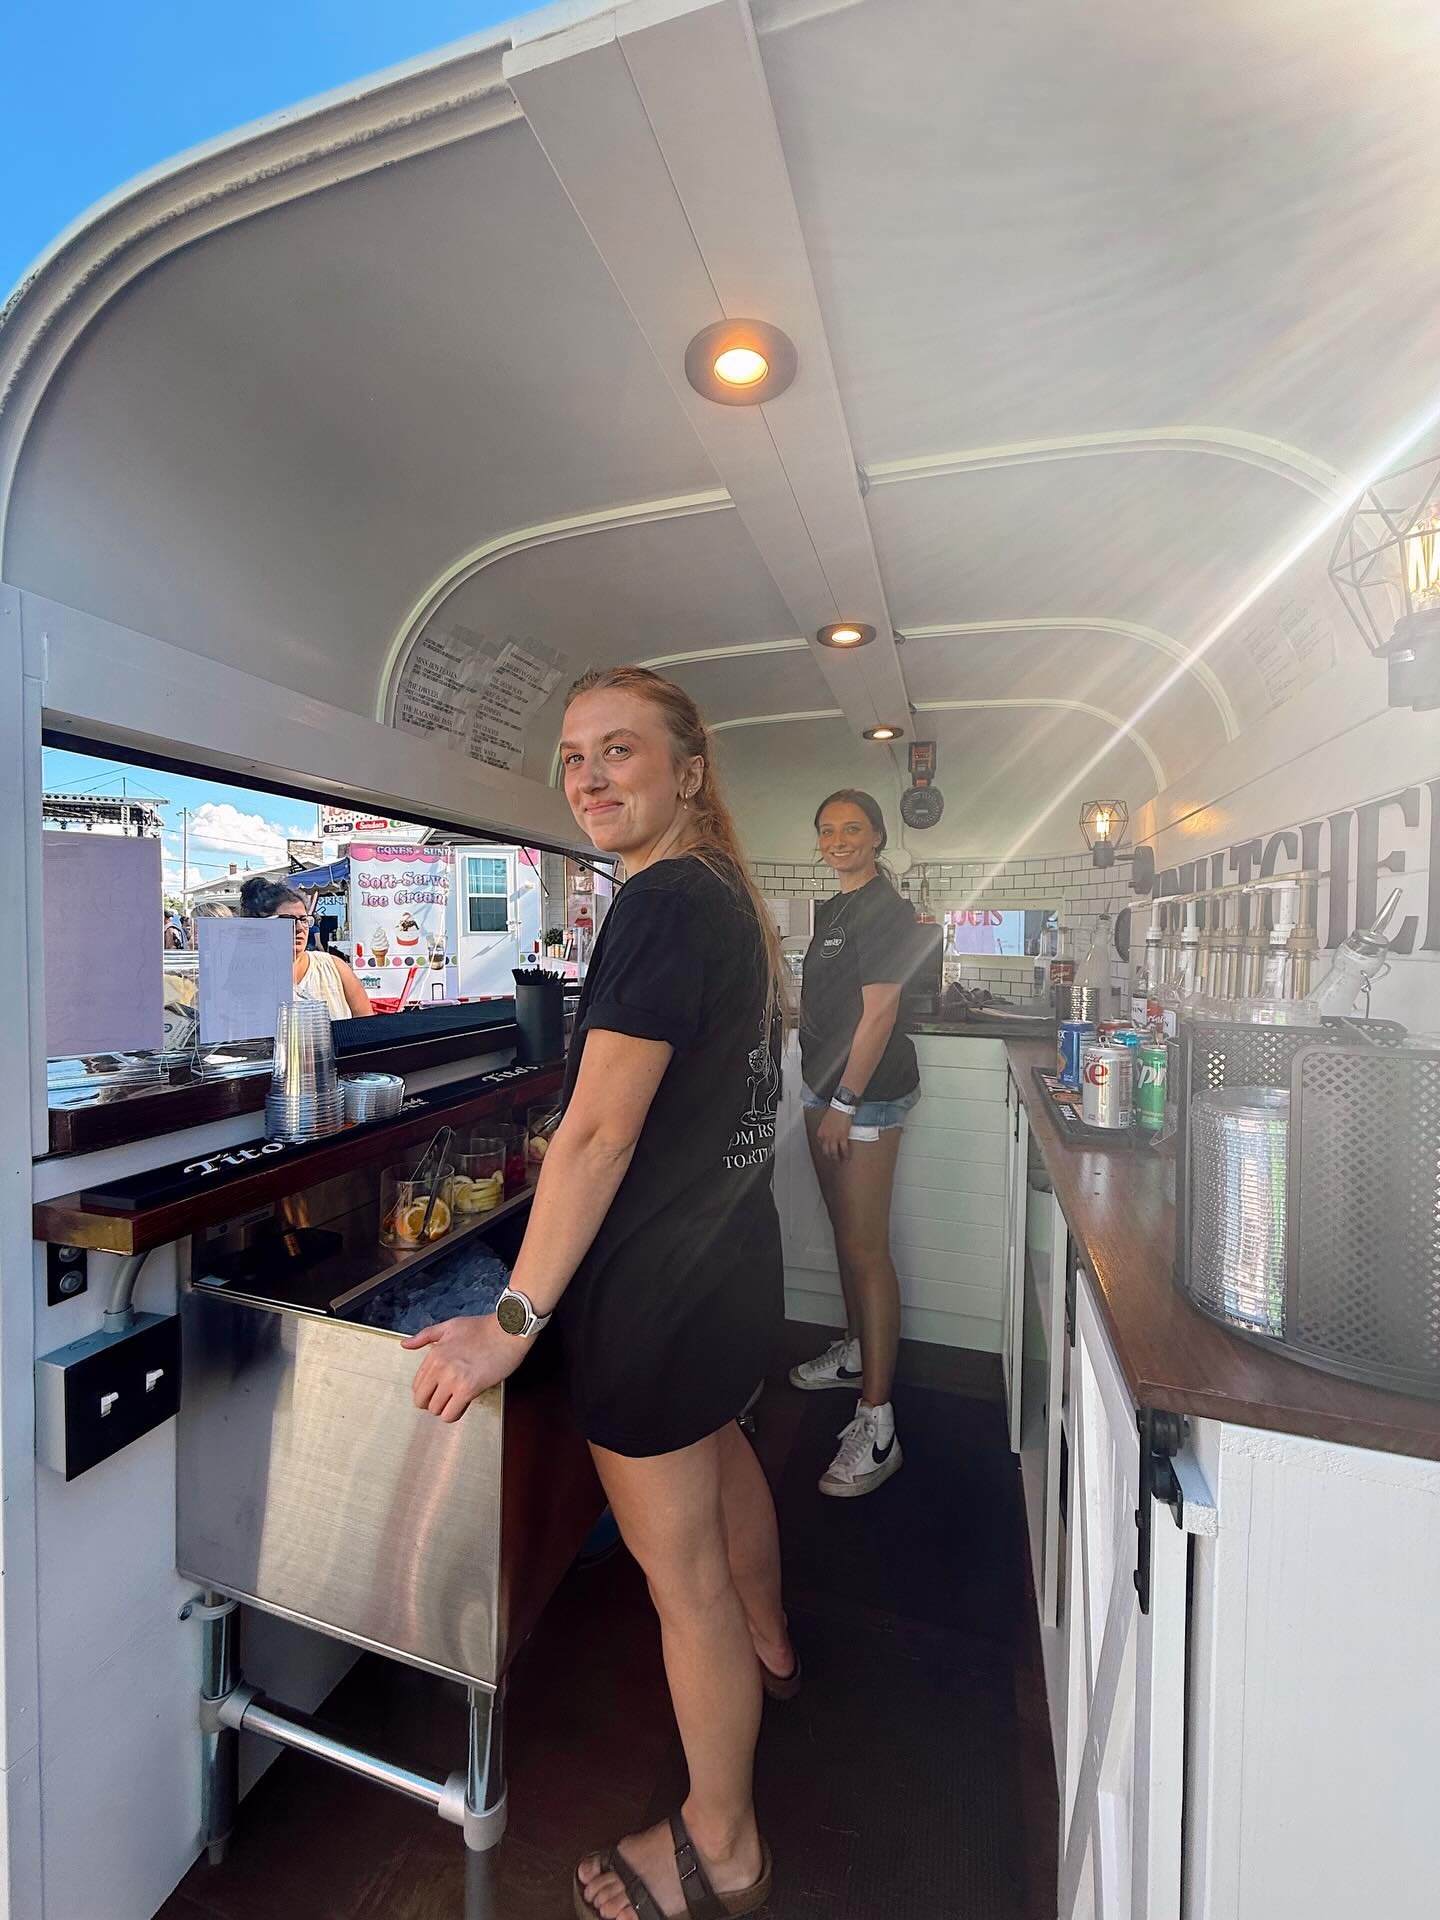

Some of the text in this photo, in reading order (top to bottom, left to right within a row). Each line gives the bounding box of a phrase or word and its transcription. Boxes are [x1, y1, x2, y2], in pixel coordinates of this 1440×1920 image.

[358, 871, 450, 890] Soft-Serve
[361, 889, 448, 908] Ice Cream
